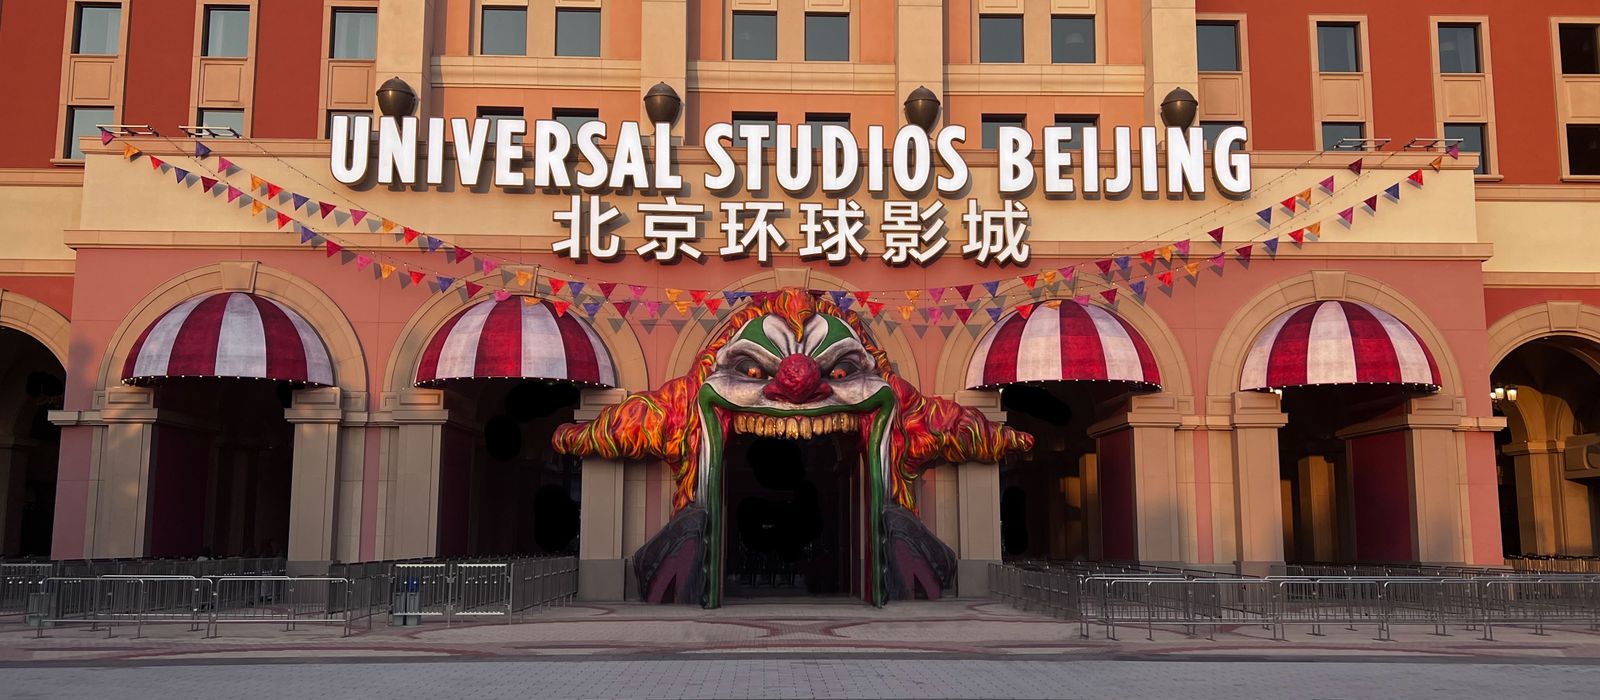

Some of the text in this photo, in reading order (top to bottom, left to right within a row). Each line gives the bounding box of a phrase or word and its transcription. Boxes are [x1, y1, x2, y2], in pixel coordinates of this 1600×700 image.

[330, 114, 1252, 195] UNIVERSAL STUDIOS BEIJING
[551, 195, 1031, 264] 北京环球影城
